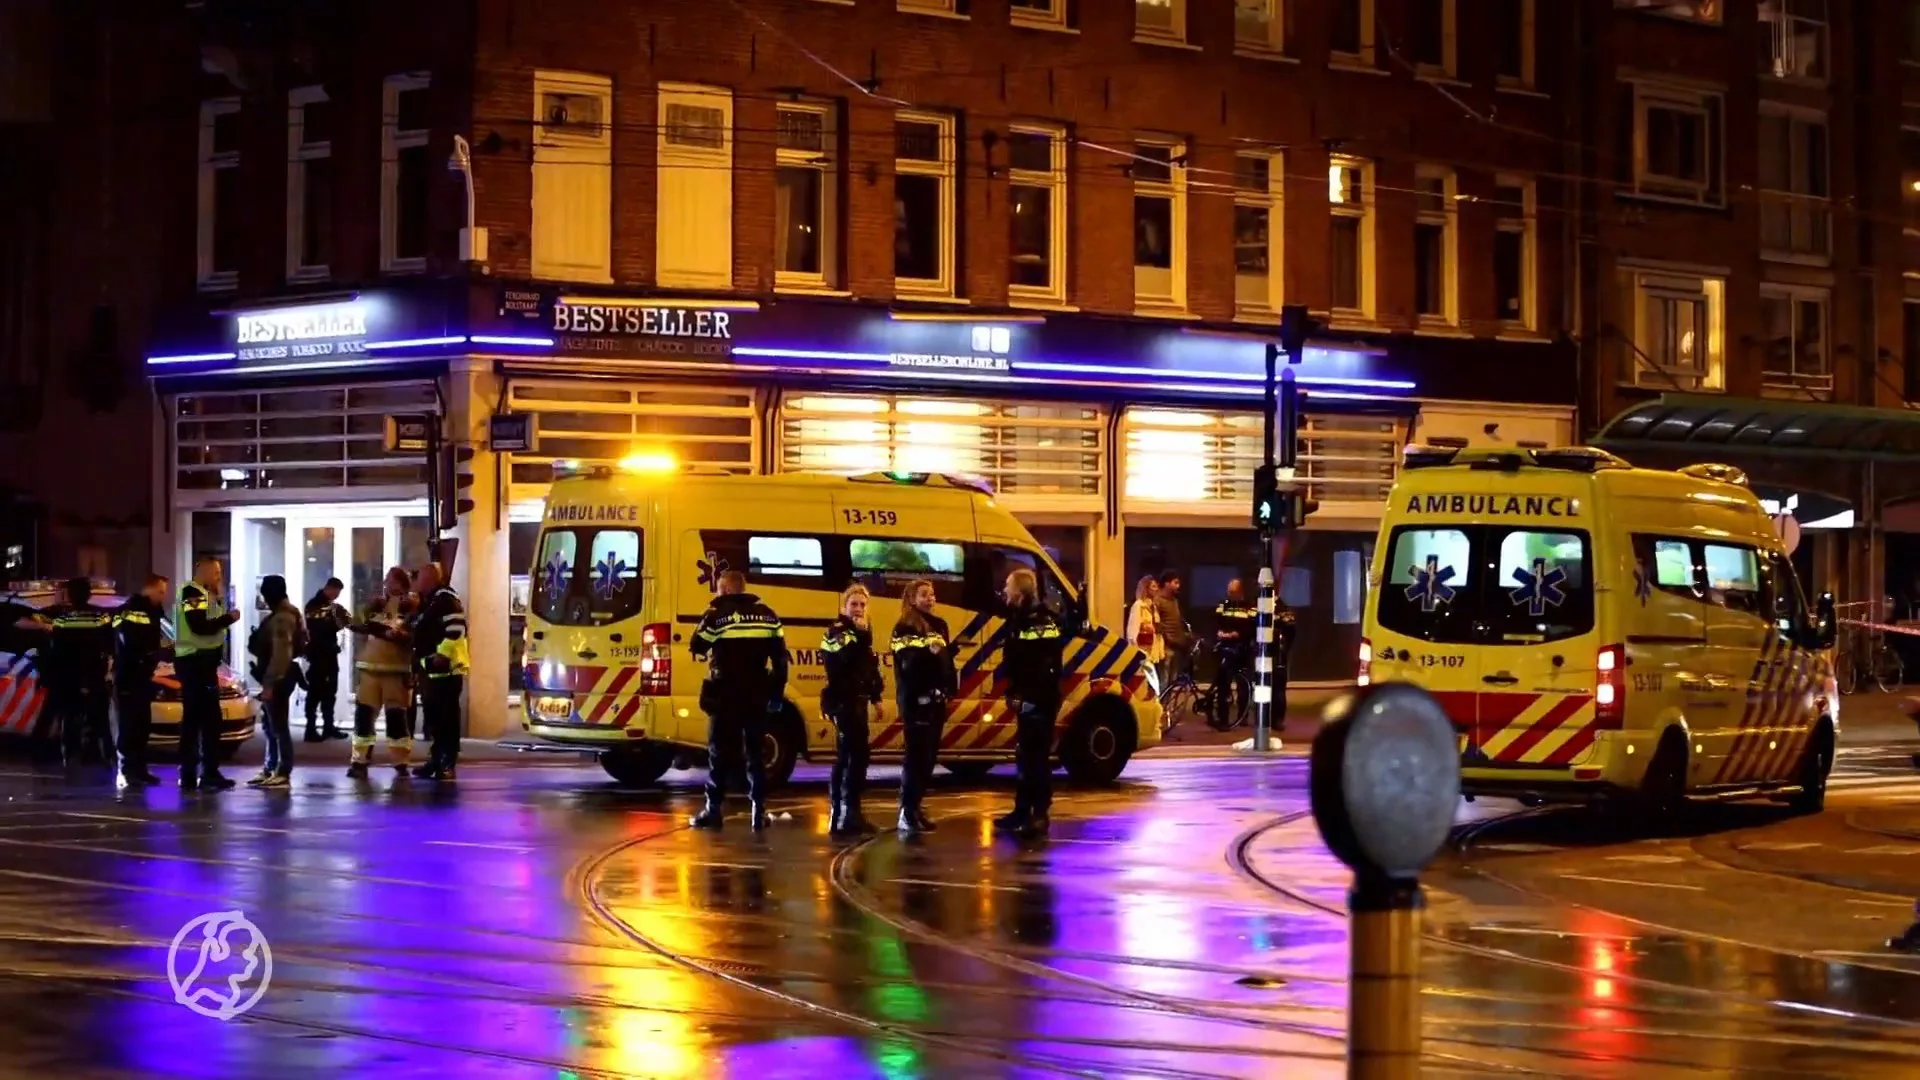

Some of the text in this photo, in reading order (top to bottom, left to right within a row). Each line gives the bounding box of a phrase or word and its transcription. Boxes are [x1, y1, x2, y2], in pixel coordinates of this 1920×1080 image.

[553, 304, 731, 338] BESTSELLER
[550, 505, 638, 521] AMBULANCE
[1407, 496, 1579, 517] AMBULANCE
[842, 508, 897, 526] 13-159
[610, 647, 640, 657] 13-159
[1421, 654, 1465, 668] 13-107
